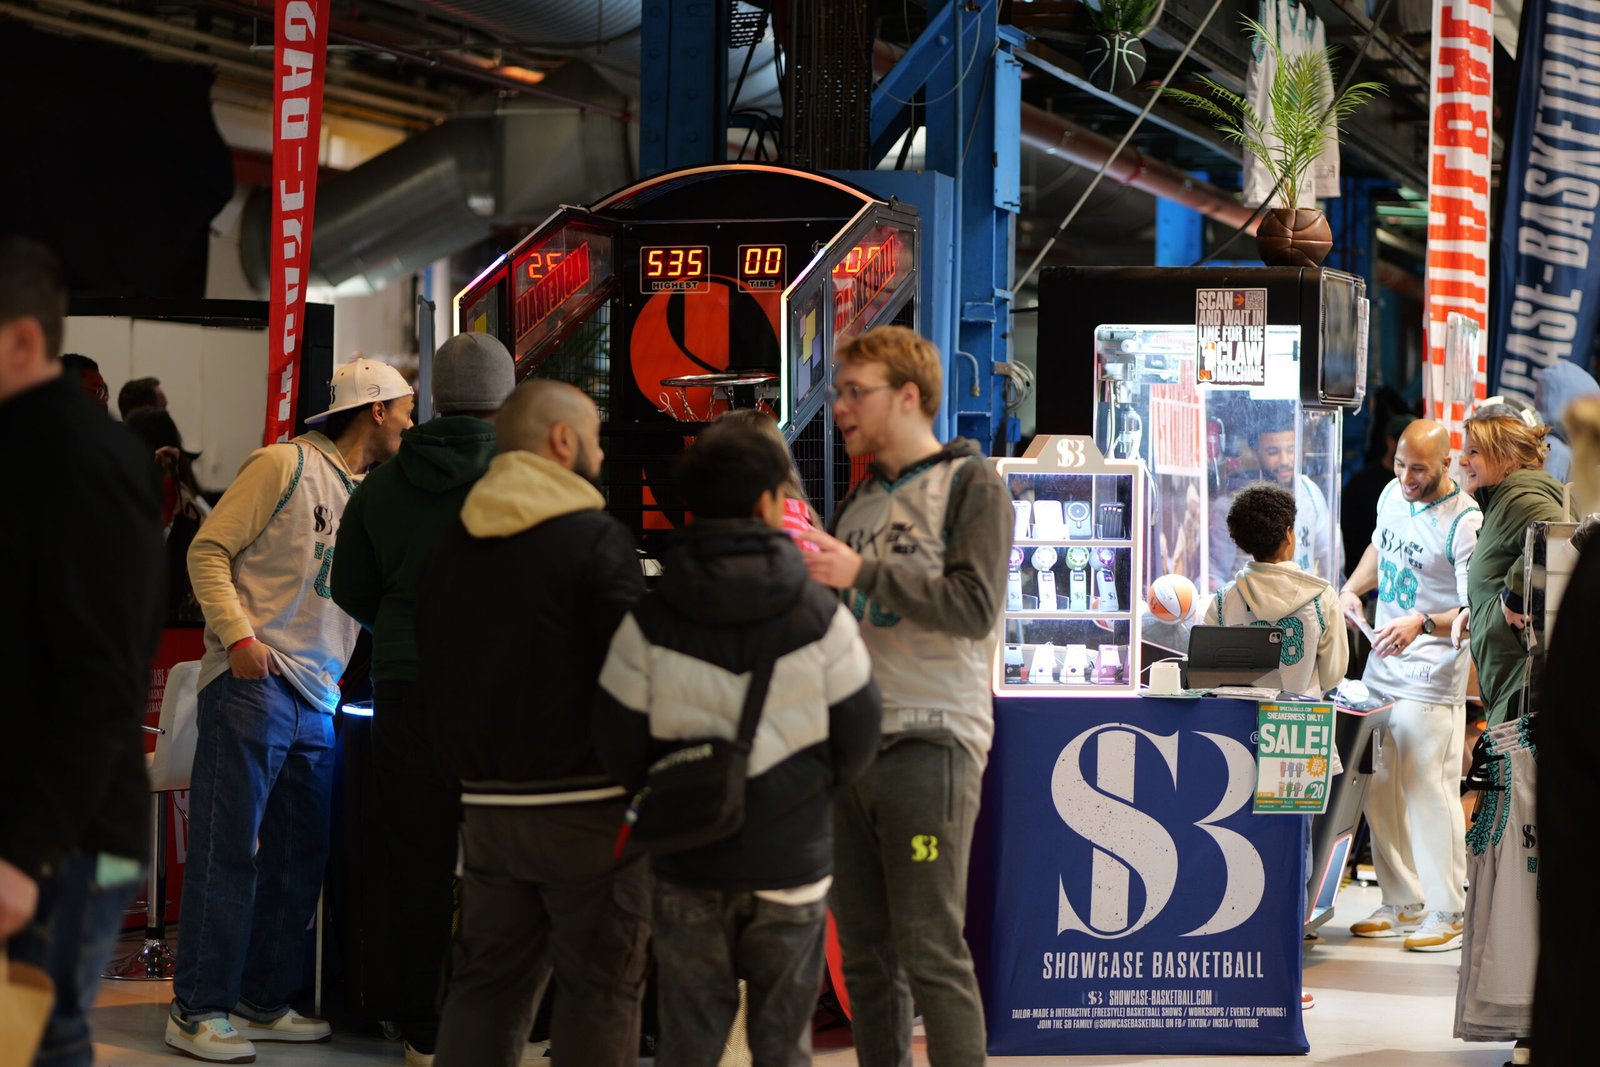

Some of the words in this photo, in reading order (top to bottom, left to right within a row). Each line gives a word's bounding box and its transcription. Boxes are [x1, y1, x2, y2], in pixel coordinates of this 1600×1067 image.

[648, 250, 702, 276] 535
[744, 248, 781, 274] 00
[652, 281, 699, 290] HIGHEST
[749, 280, 775, 288] TIME
[1199, 291, 1233, 310] SCAN
[1199, 310, 1221, 325] AND
[1223, 310, 1251, 325] WAIT
[1252, 310, 1264, 325] IN
[1199, 326, 1221, 341] LINE
[1222, 326, 1242, 341] FOR
[1244, 326, 1264, 341] THE
[1217, 342, 1264, 366] CLAW
[1217, 366, 1264, 382] MACHINE
[1267, 712, 1306, 720] SNEAKERNESS
[1260, 723, 1329, 755] SALE!
[1043, 951, 1144, 979] SHOWCASE
[1152, 951, 1264, 979] BASKETBALL
[1109, 990, 1212, 1005] SHOWCASE-BASKETBALL.COM
[1012, 1008, 1049, 1019] TAILOR-MADE
[1050, 1008, 1055, 1017] &
[1055, 1008, 1090, 1018] INTERACTIVE
[1127, 1007, 1160, 1017] BASKETBALL
[1162, 1007, 1182, 1016] SHOWS
[1183, 1007, 1187, 1016] /
[1189, 1007, 1224, 1016] WORKSHOPS
[1225, 1007, 1229, 1016] /
[1230, 1007, 1250, 1016] EVENTS
[1251, 1007, 1255, 1016] /
[1037, 1020, 1051, 1029] JOIN
[1053, 1019, 1063, 1029] THE
[1073, 1019, 1093, 1028] FAMILY
[1094, 1019, 1164, 1029] @SHOWCASEBASKETBALL
[1166, 1019, 1174, 1028] ON
[1235, 1018, 1259, 1028] YOUTUBE
